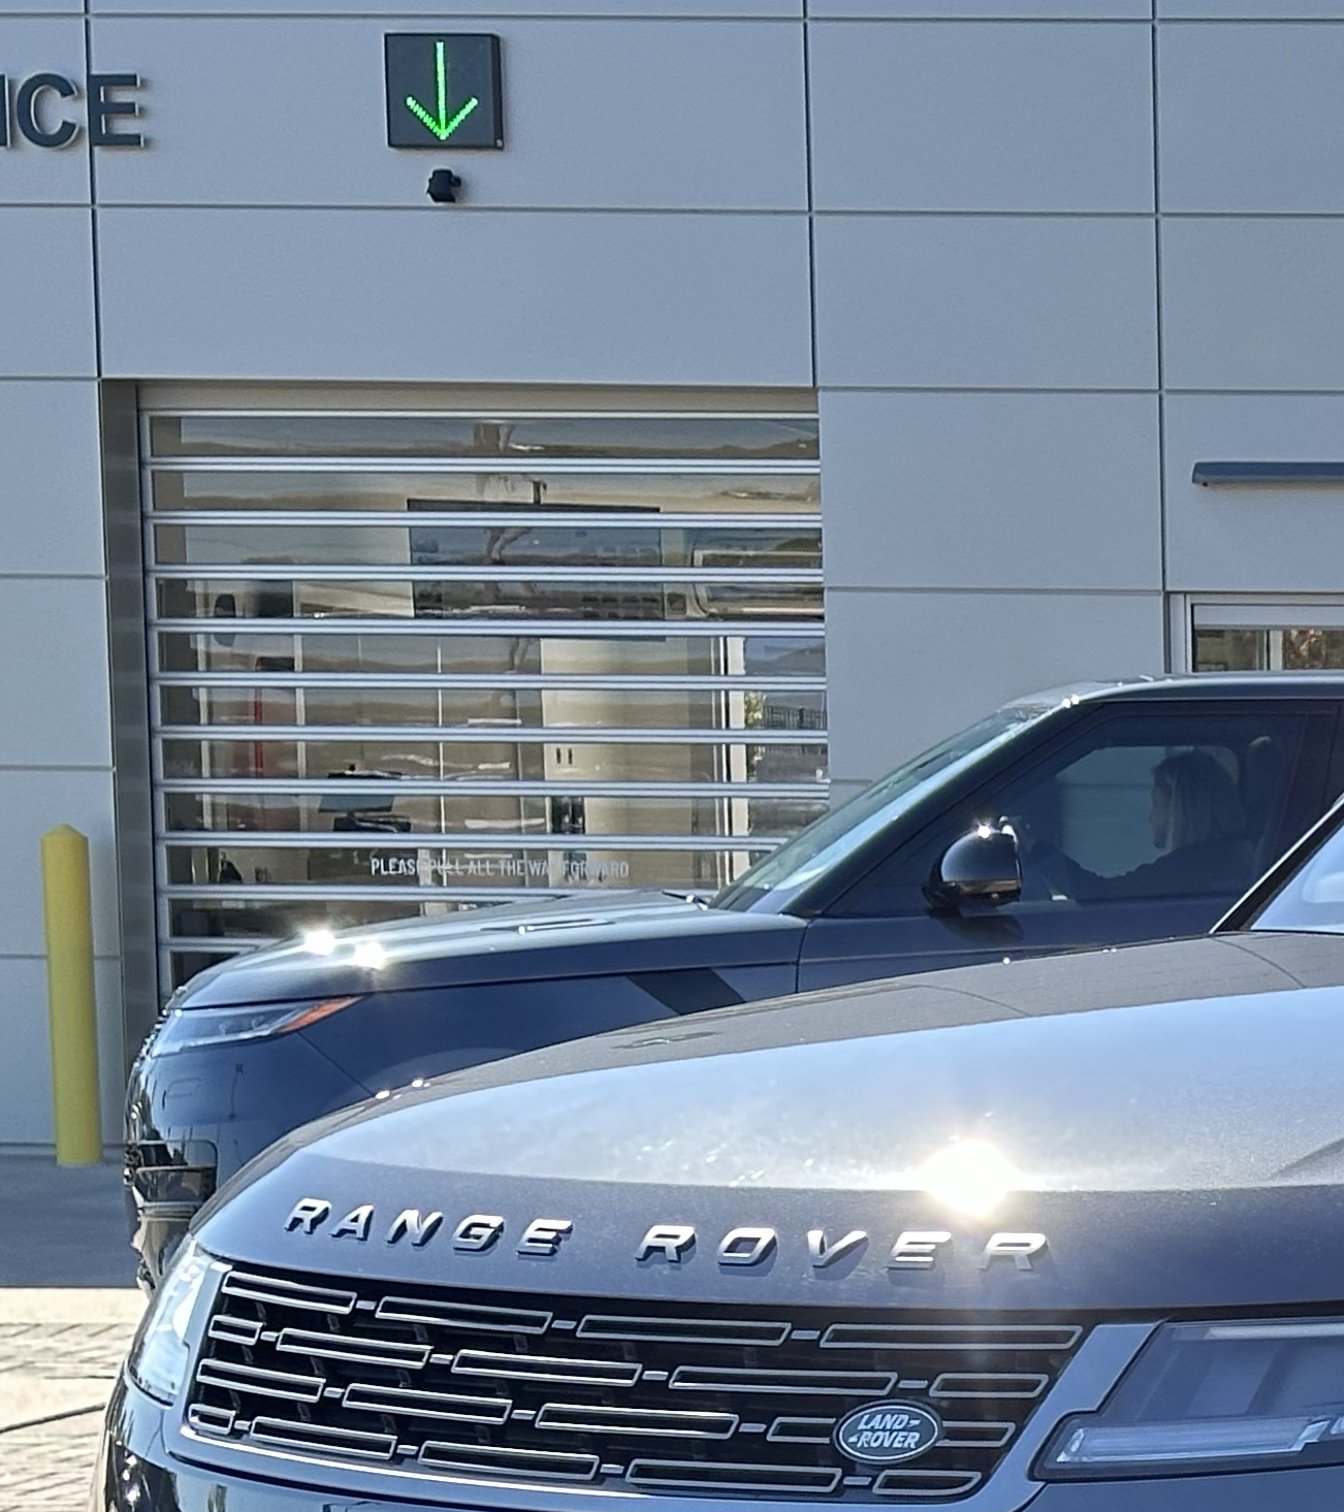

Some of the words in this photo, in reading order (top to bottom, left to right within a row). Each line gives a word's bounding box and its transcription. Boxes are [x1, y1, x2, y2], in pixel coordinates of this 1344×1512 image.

[371, 858, 425, 876] PLEAS
[467, 859, 495, 876] ALL
[499, 859, 525, 877] THE
[528, 860, 556, 877] WA
[284, 1197, 573, 1257] RANGE
[634, 1223, 1048, 1271] ROVER
[856, 1431, 920, 1449] ROVER
